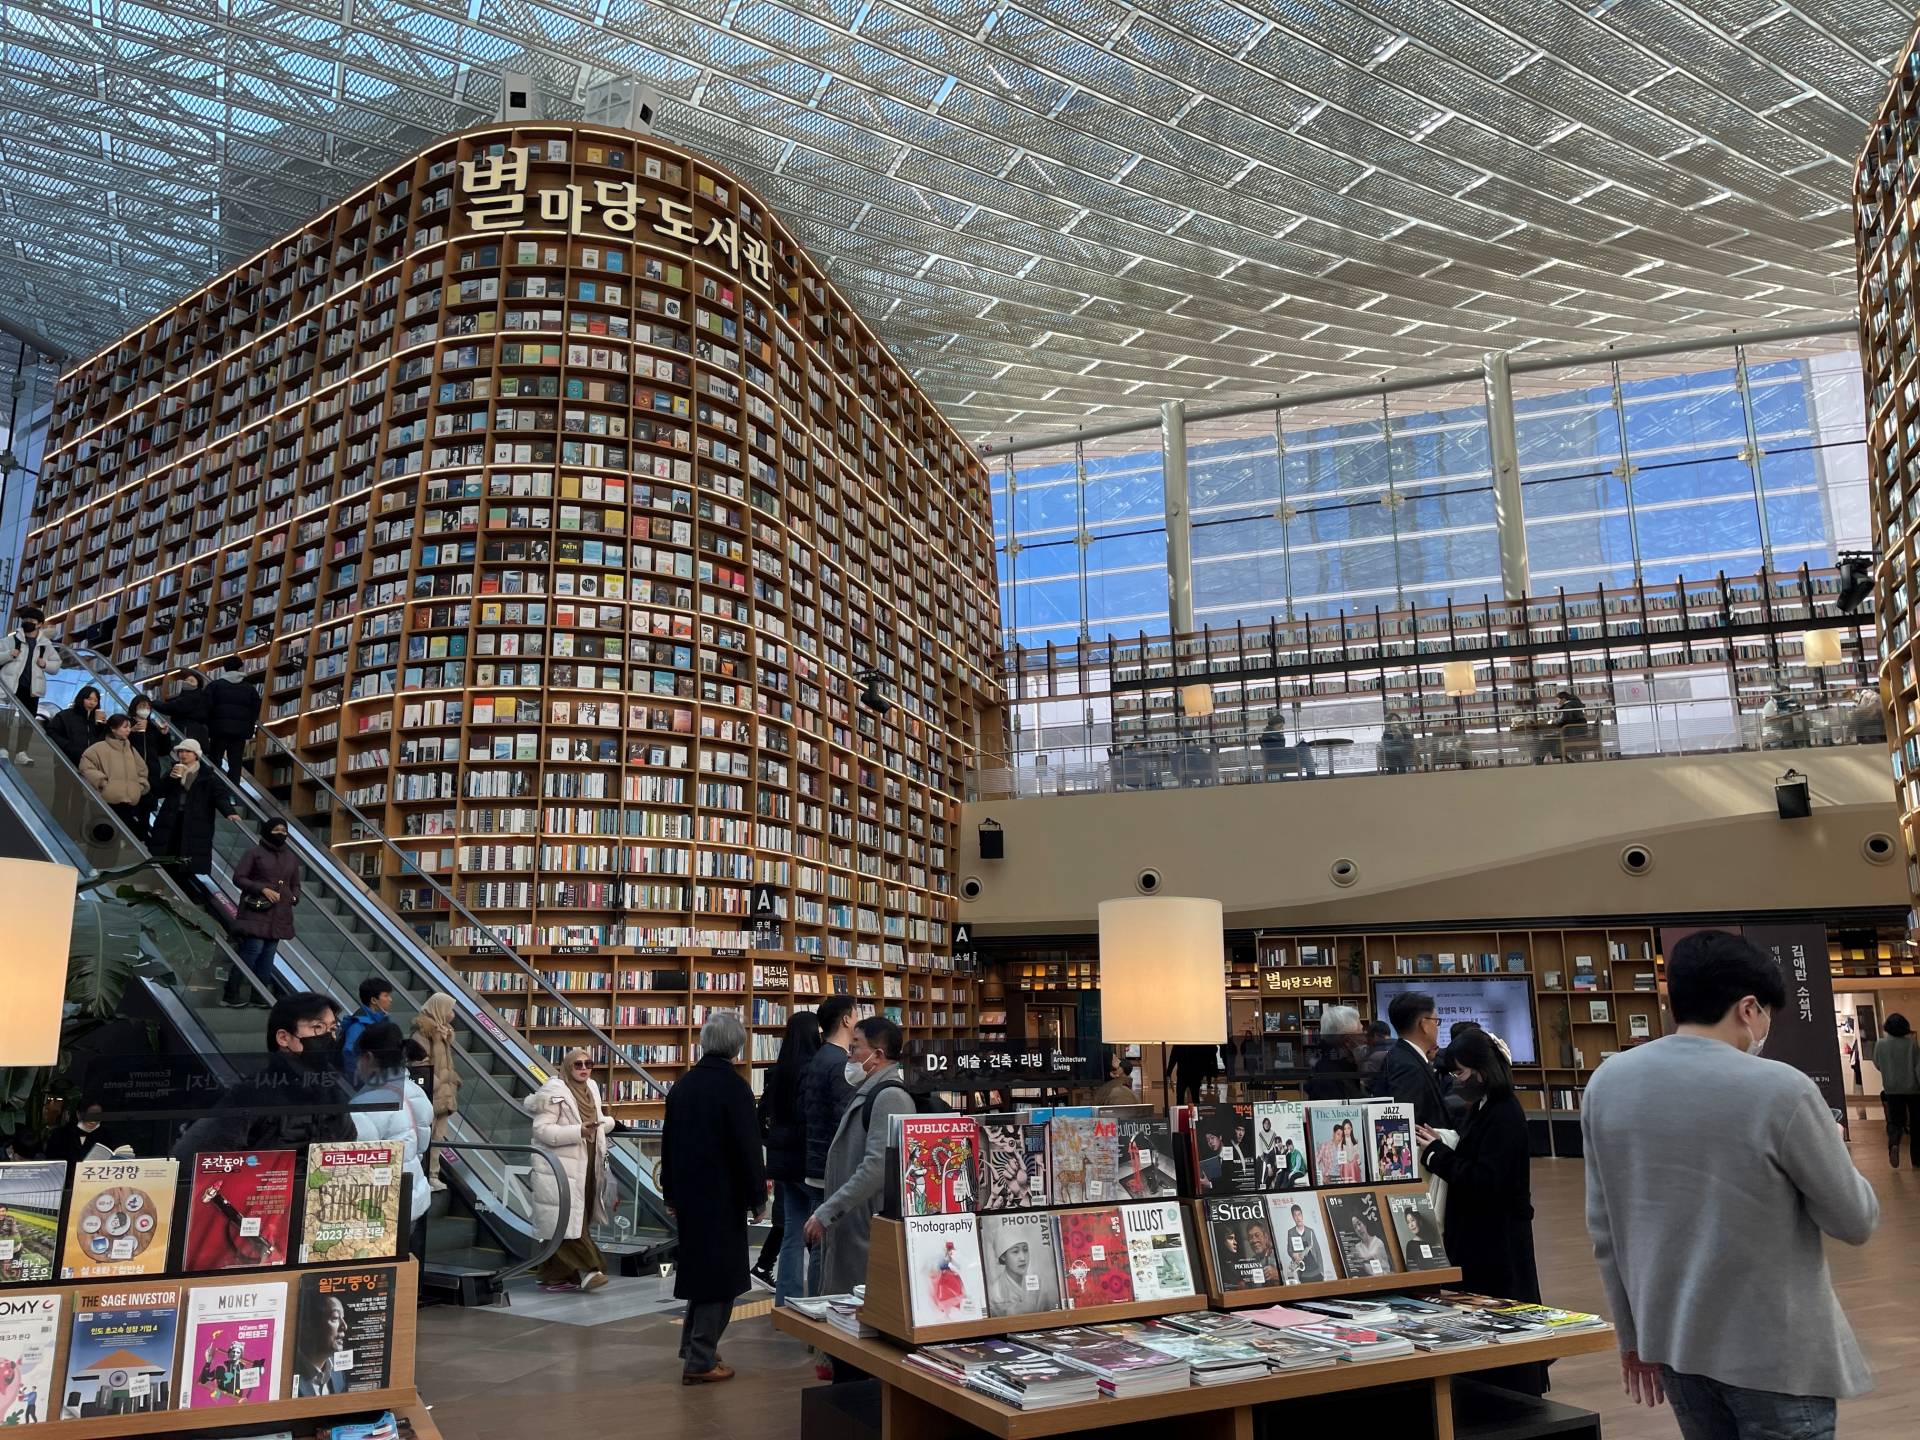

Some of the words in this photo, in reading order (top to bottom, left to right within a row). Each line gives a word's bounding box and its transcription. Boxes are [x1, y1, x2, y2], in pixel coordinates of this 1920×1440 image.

[458, 146, 646, 235] 별마당
[652, 196, 773, 291] 도서관
[757, 889, 771, 910] A
[955, 926, 969, 943] A
[954, 952, 970, 961] 소설
[1791, 944, 1807, 982] 김애란
[763, 965, 789, 976] 비즈니스
[1796, 986, 1813, 1023] 소설가
[926, 1053, 948, 1071] D2
[1315, 1110, 1329, 1119] The
[1332, 1109, 1359, 1118] Musical
[1383, 1106, 1399, 1115] JAZZ
[906, 1123, 950, 1134] PUBLIC
[951, 1122, 975, 1133] ART
[1093, 1119, 1117, 1137] Art
[1117, 1122, 1151, 1137] culpture
[201, 1155, 245, 1173] 주간동아
[325, 1151, 388, 1165] 이코노미스트
[81, 1165, 140, 1180] 주간경향
[1218, 1200, 1265, 1221] Strad
[910, 1218, 973, 1234] Photography
[1002, 1215, 1039, 1227] PHOTO
[1127, 1209, 1164, 1232] ILLUST
[316, 1230, 343, 1241] 2023
[366, 1227, 385, 1239] 전략
[1040, 1223, 1051, 1247] ART
[319, 1274, 379, 1293] 월간중앙
[81, 1295, 100, 1308] THE
[101, 1294, 127, 1307] SAGE
[128, 1291, 176, 1305] INVESTOR
[218, 1293, 258, 1309] MONEY
